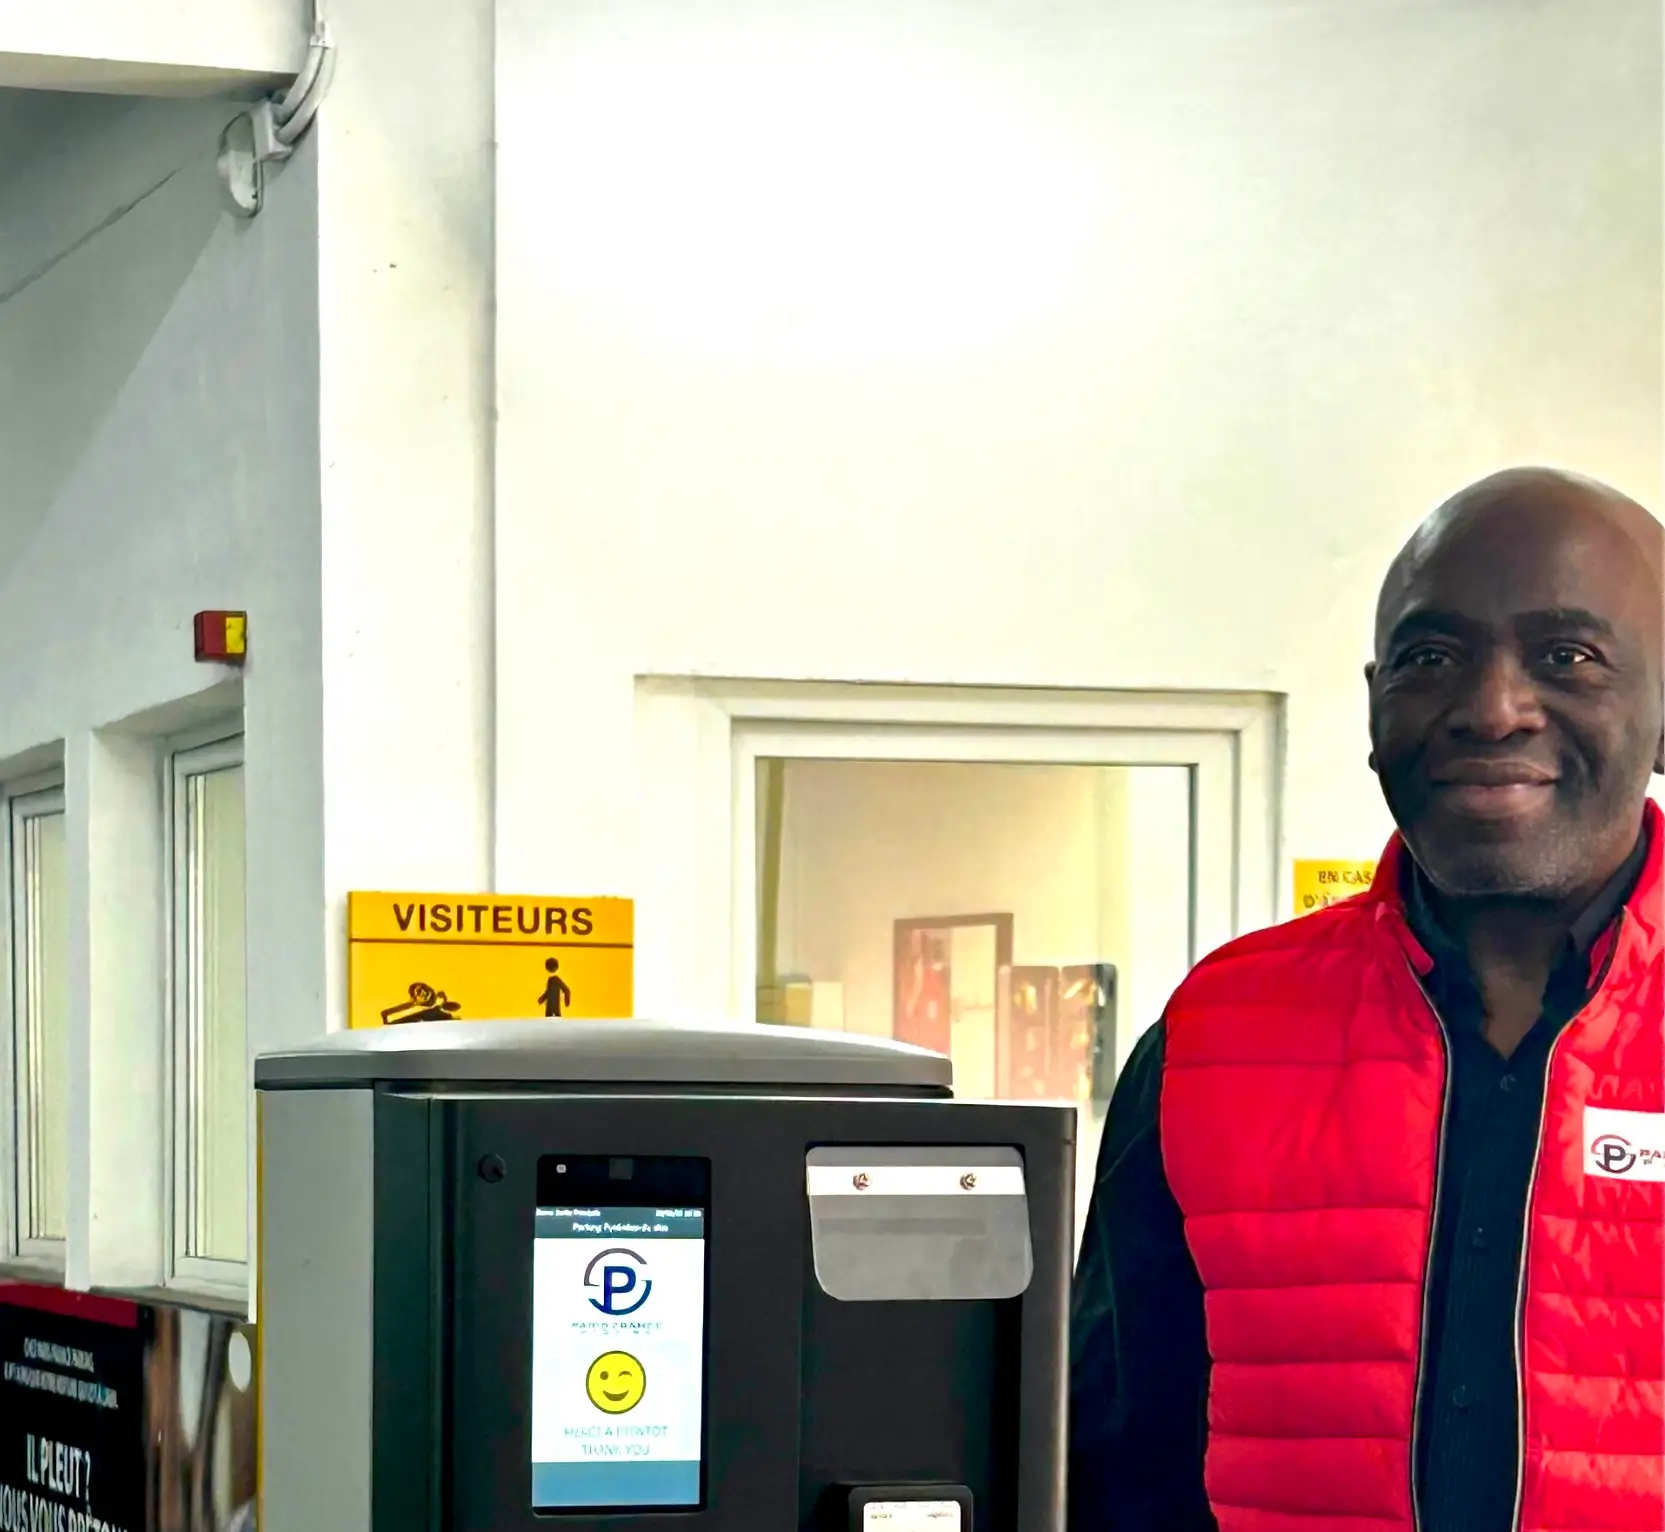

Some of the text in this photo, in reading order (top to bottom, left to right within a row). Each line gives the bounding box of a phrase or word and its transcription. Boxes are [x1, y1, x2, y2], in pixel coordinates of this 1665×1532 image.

[392, 903, 594, 936] VISITEURS
[26, 1433, 39, 1484] IL
[40, 1436, 83, 1499] PLEUT
[625, 1444, 651, 1456] YOU
